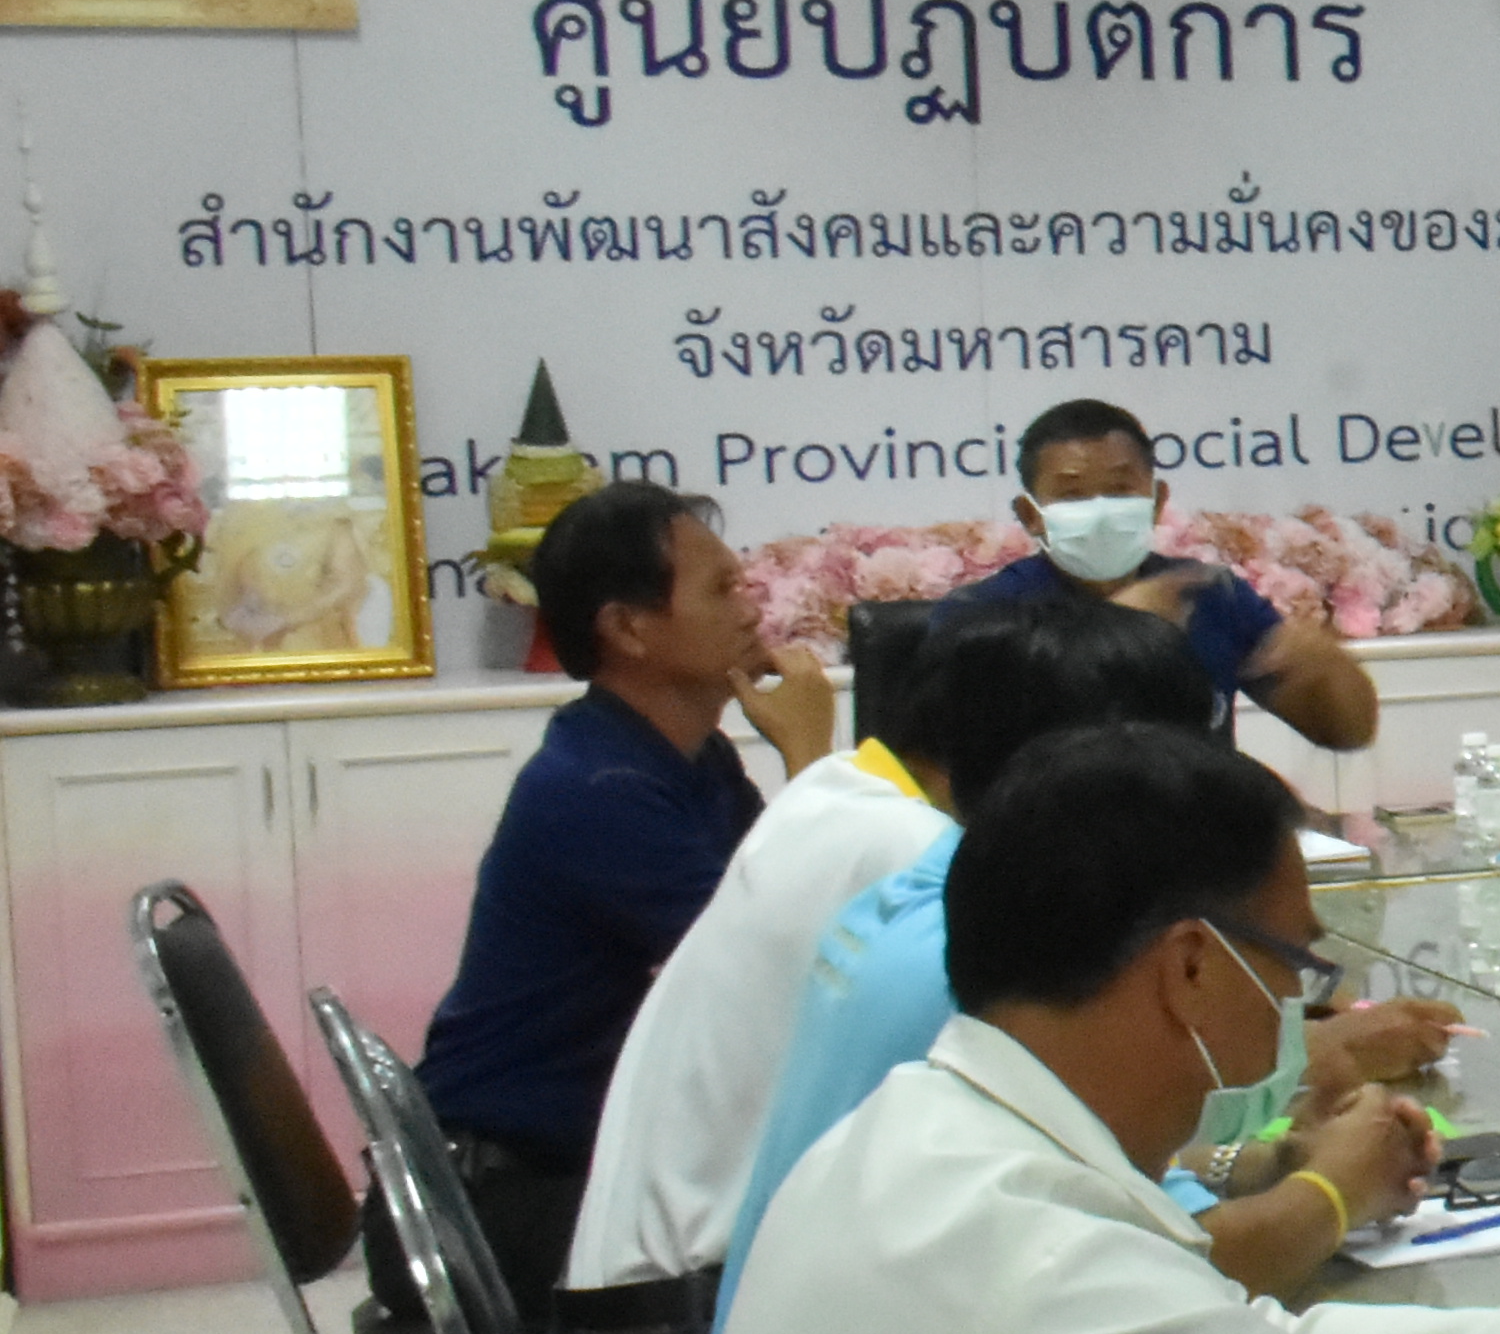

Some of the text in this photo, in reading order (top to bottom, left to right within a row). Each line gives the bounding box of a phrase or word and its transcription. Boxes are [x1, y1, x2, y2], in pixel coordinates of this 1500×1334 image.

[673, 304, 1272, 379] จังหวัดมหาสารคาม
[715, 424, 1024, 486] Provinci
[1149, 413, 1304, 470] ocial
